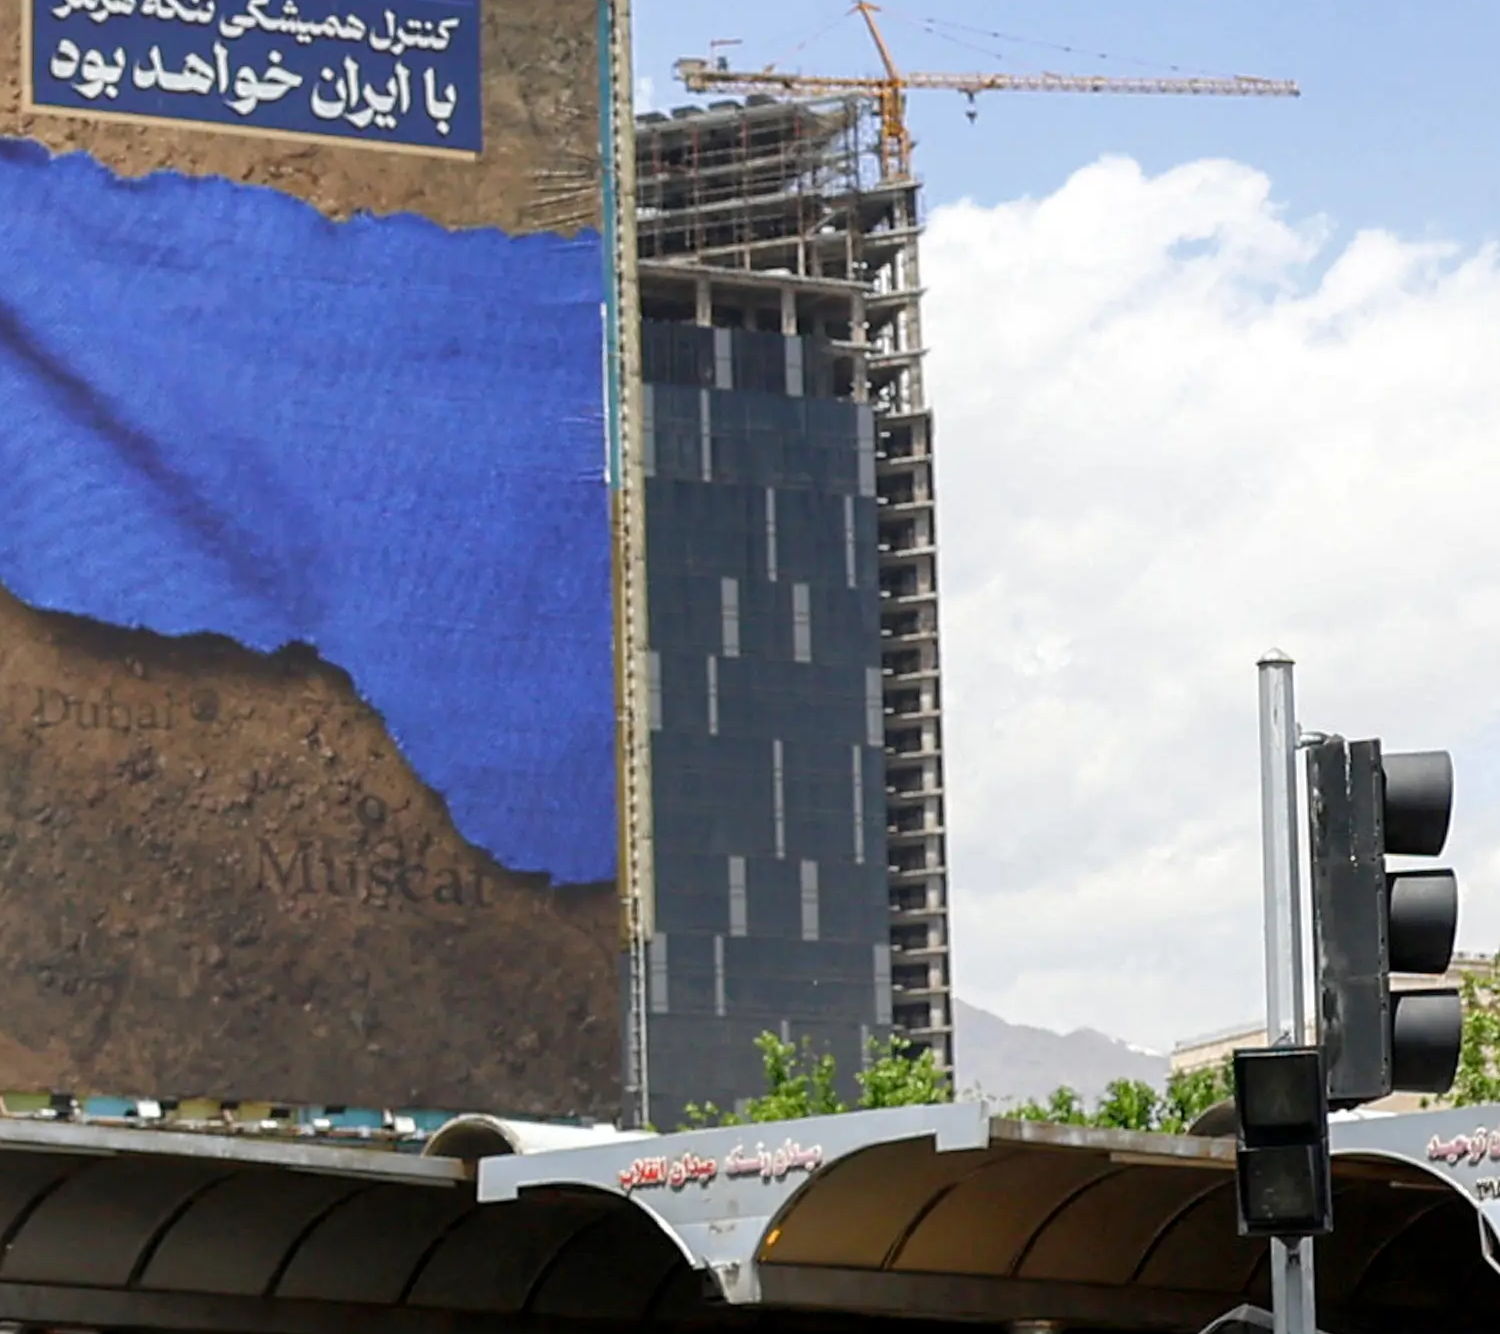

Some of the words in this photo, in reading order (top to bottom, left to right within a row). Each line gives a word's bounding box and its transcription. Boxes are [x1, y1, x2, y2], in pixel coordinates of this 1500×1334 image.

[368, 10, 460, 56] کنترل
[49, 38, 126, 99] بود
[132, 41, 302, 116] خواهد
[311, 55, 410, 129] ایران
[424, 67, 457, 134] با
[256, 835, 494, 909] Muscat
